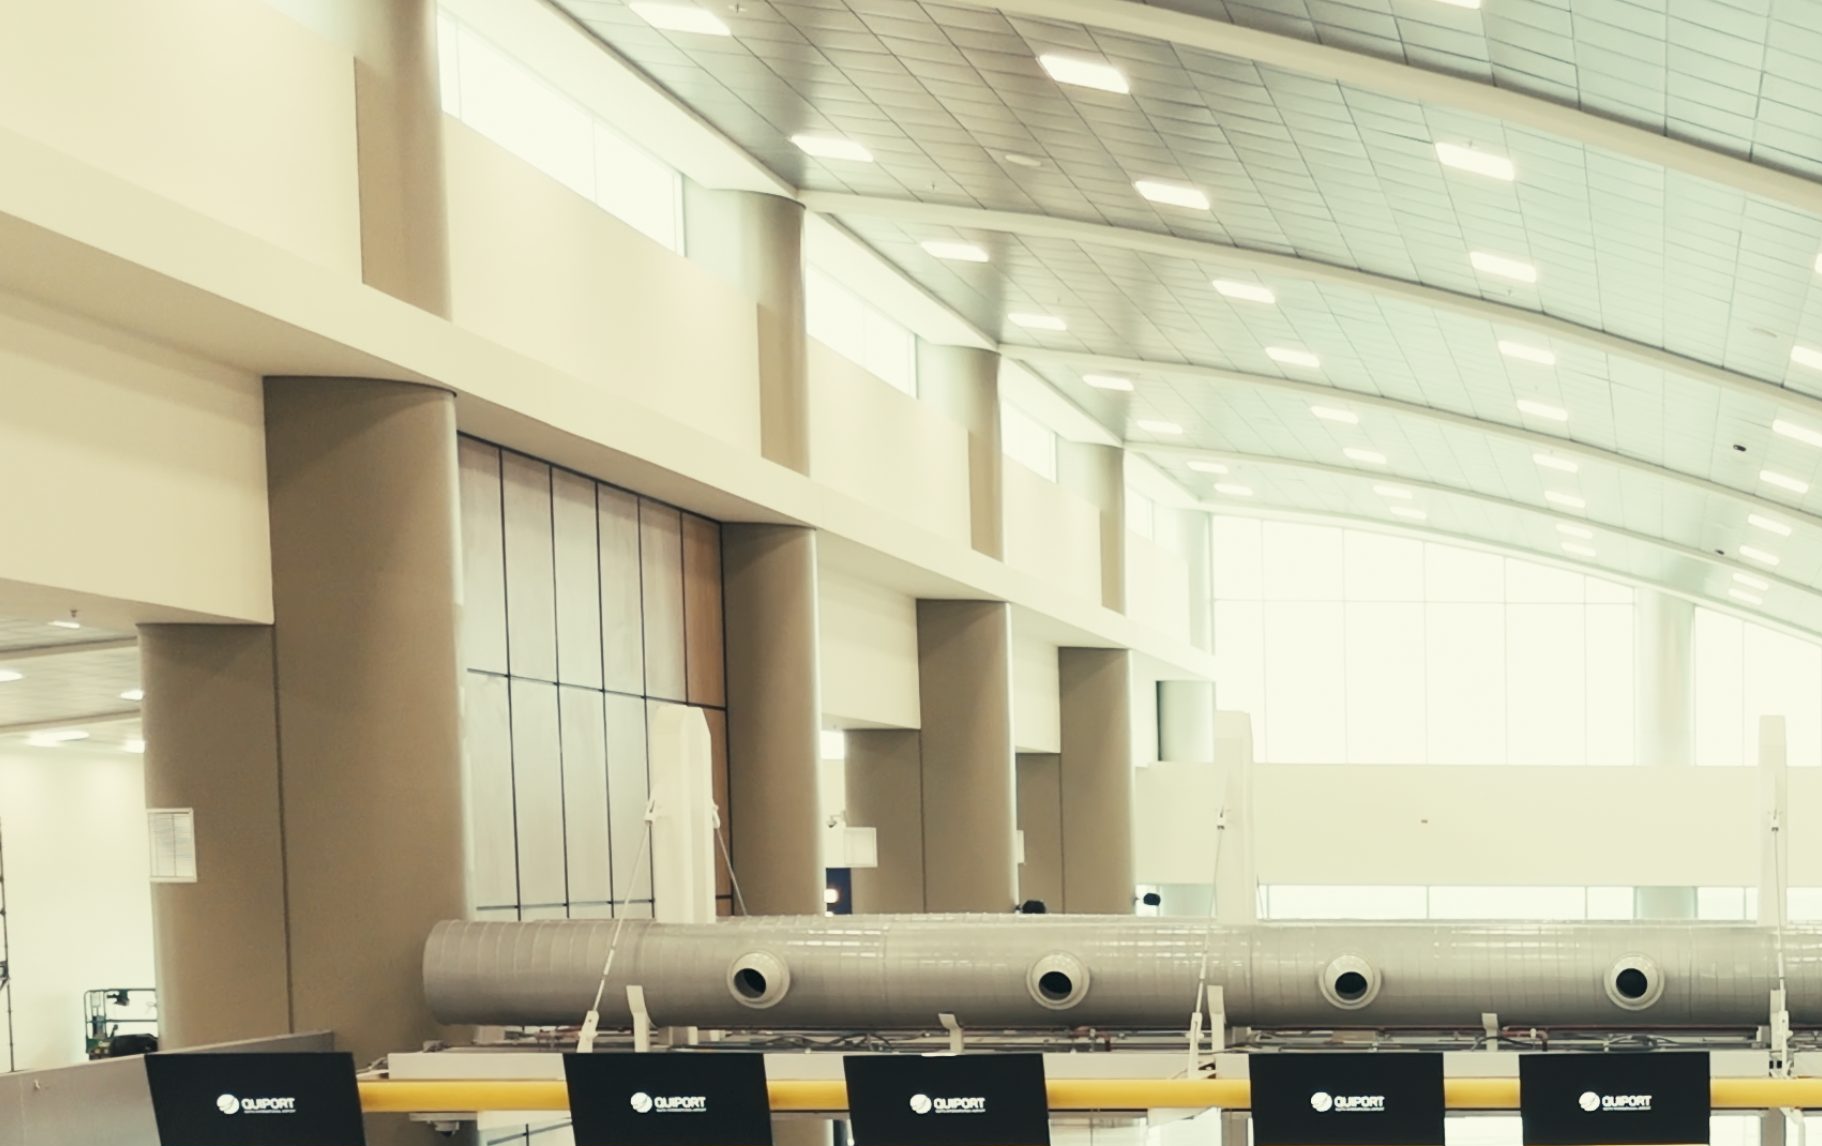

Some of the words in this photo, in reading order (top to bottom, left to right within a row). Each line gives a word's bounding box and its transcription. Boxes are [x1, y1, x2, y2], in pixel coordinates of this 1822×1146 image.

[241, 1097, 296, 1110] QUIPORT
[654, 1096, 706, 1109] QUIPORT
[933, 1097, 986, 1109] QUIPORT
[1334, 1096, 1385, 1108] QUIPORT
[1601, 1095, 1652, 1107] QUIPORT
